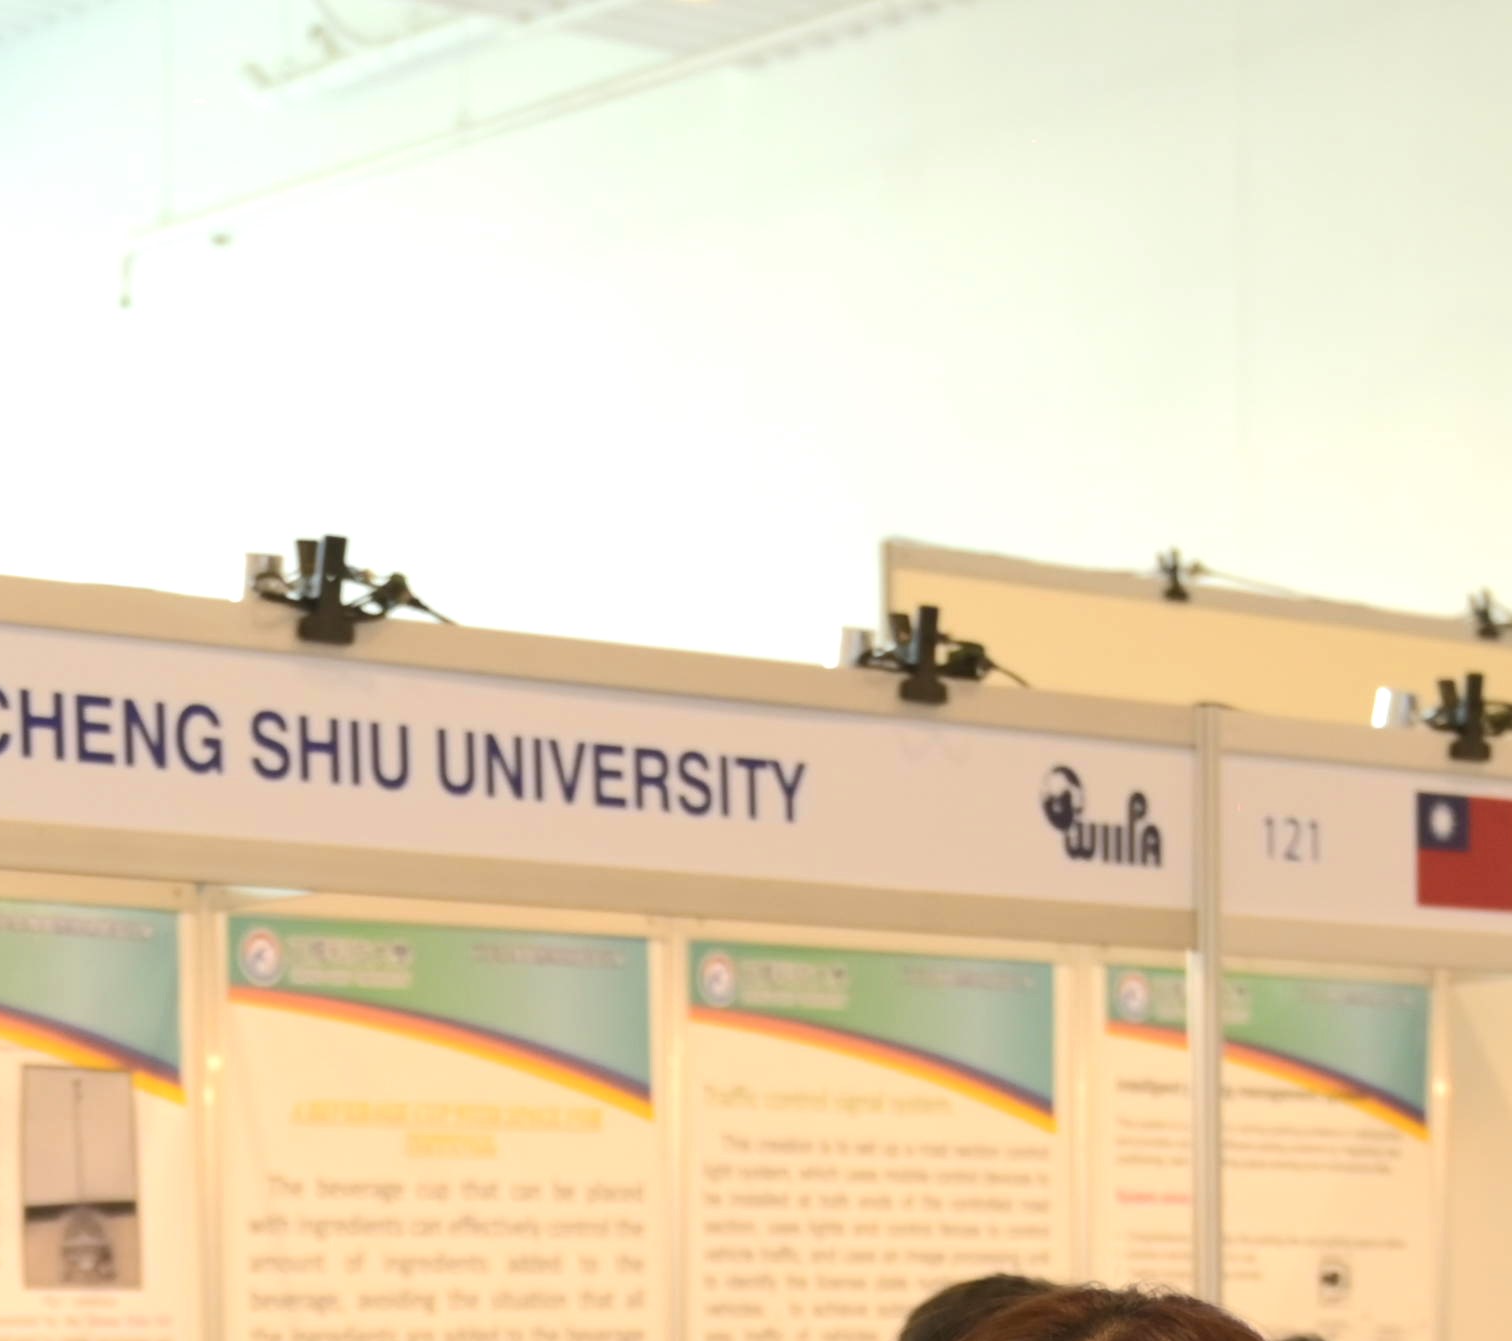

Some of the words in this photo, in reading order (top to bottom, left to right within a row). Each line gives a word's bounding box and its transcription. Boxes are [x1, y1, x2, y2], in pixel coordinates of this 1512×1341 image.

[251, 707, 412, 790] SHIU
[436, 726, 806, 823] UNIVERSITY
[1262, 815, 1322, 865] 121
